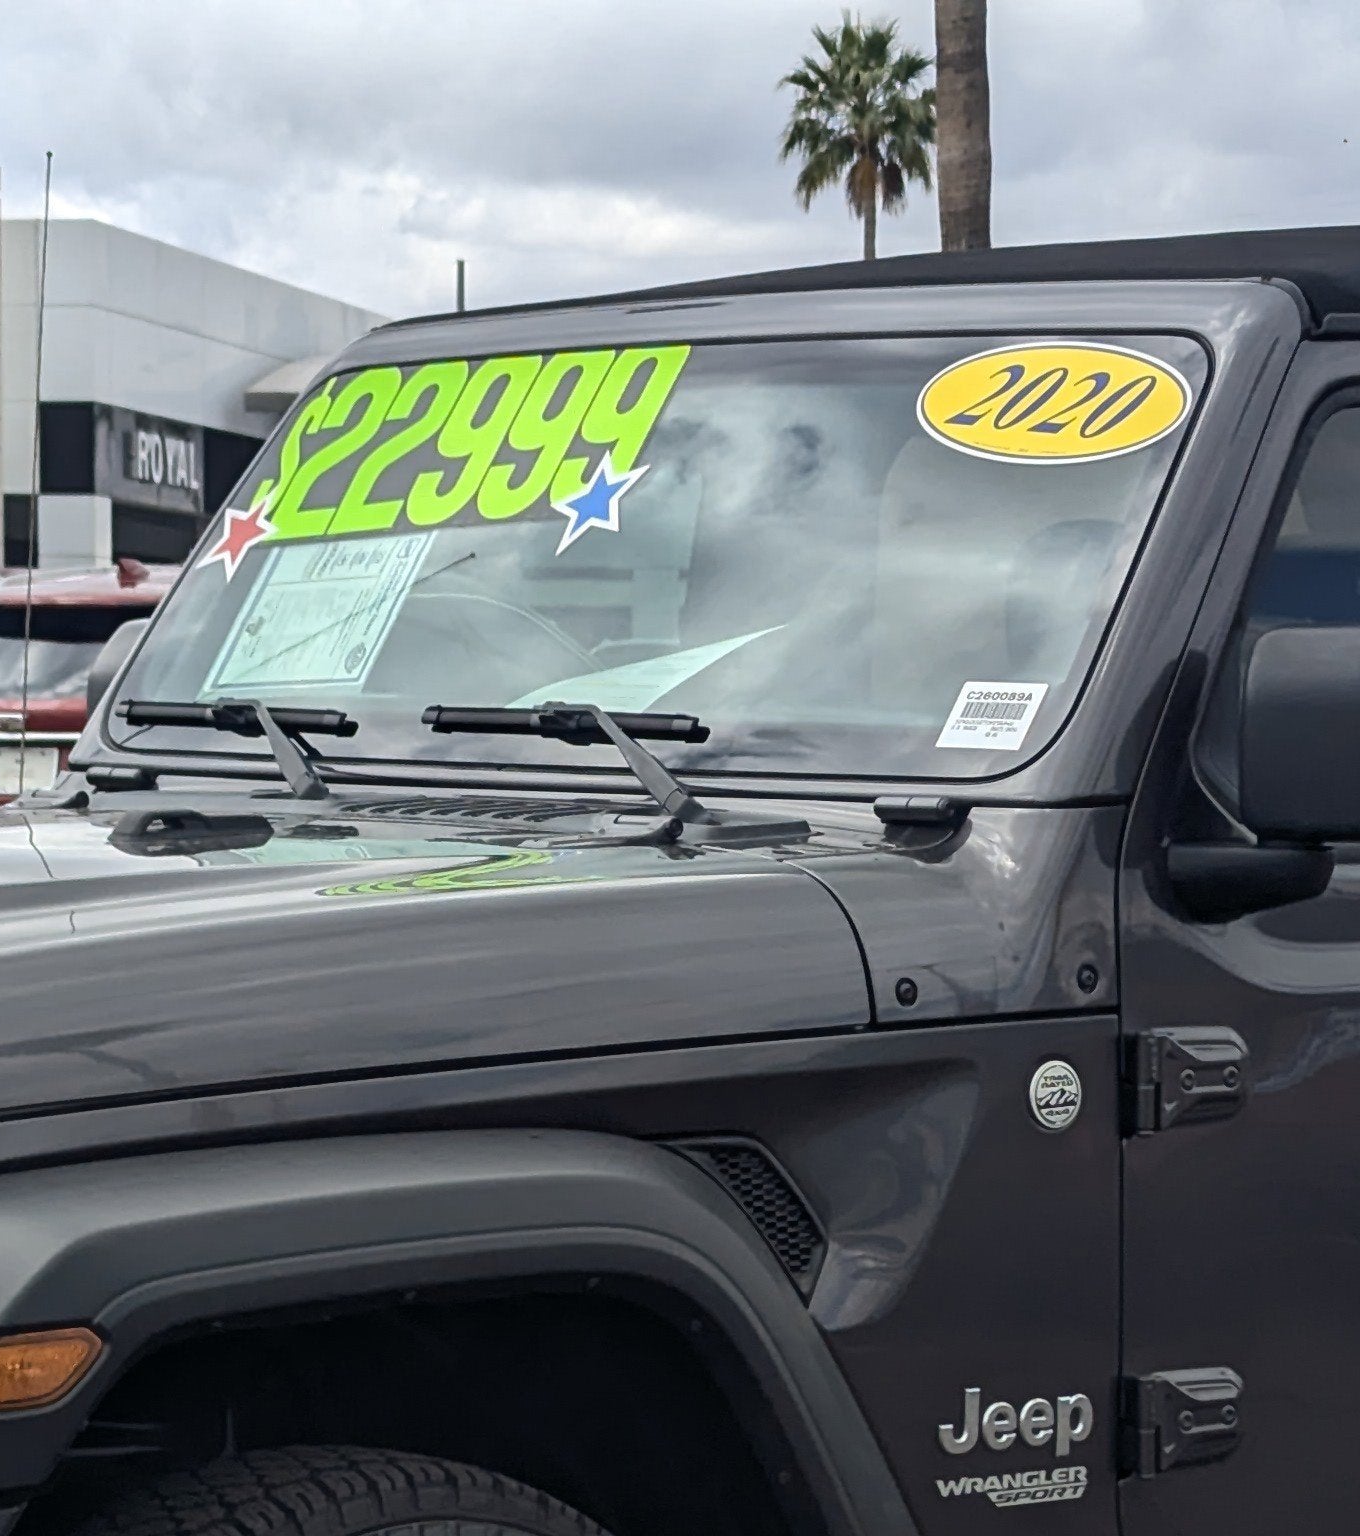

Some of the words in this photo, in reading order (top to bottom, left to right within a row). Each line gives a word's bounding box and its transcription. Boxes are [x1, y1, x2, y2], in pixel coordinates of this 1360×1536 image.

[944, 364, 1158, 439] 2020
[137, 431, 200, 490] ROYAL
[252, 345, 692, 542] $22999
[938, 1387, 1093, 1457] Jeep
[936, 1466, 1088, 1498] WRANGLER
[995, 1485, 1082, 1503] SPORT
